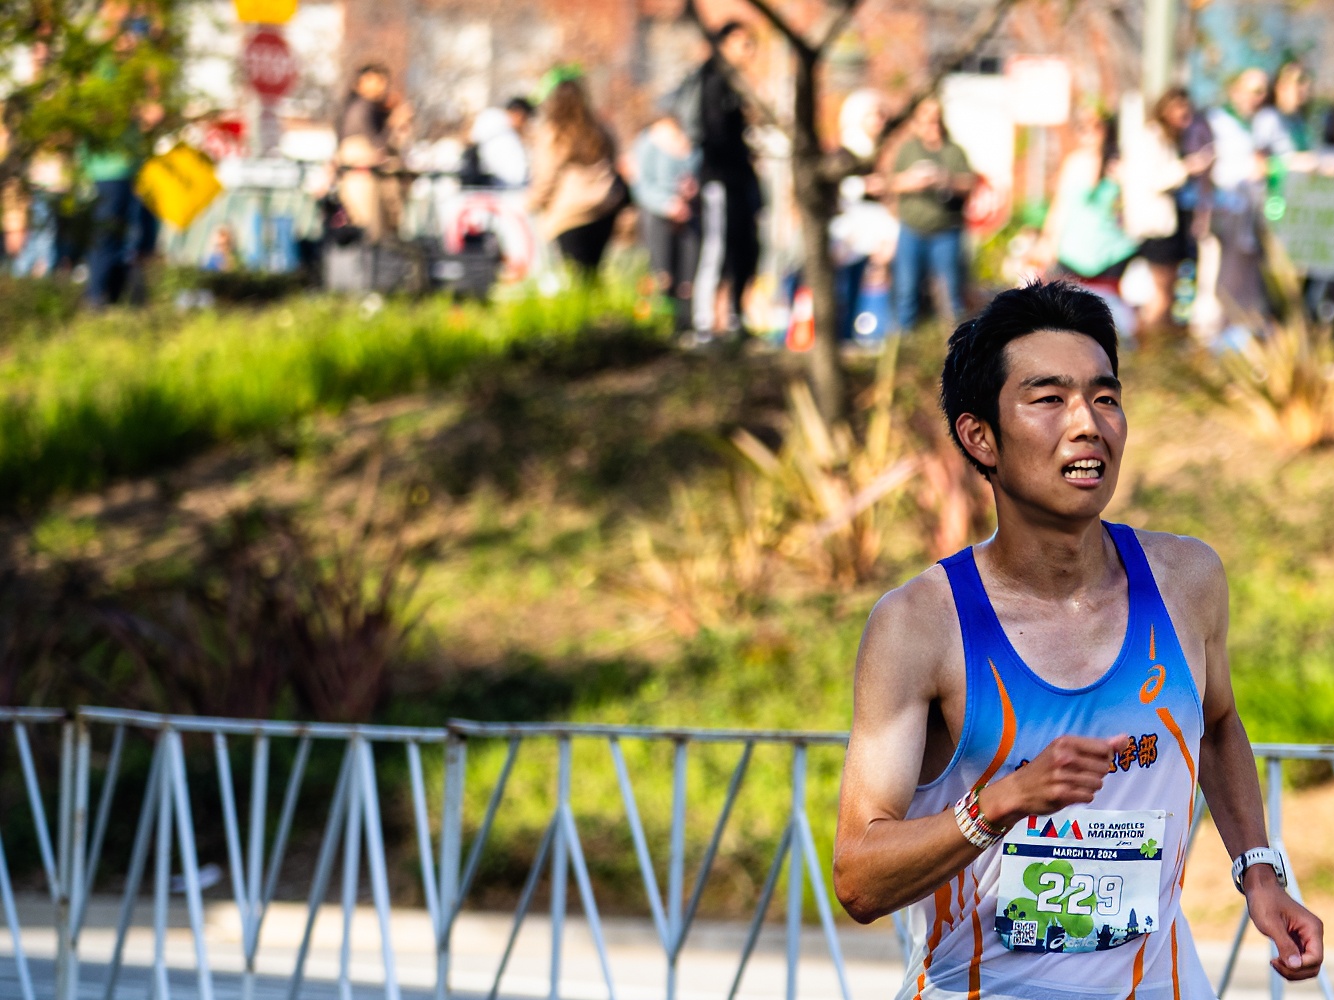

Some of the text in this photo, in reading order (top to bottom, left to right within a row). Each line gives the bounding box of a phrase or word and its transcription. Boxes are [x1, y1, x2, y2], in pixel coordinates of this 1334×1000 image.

[1088, 822, 1145, 830] LOS ANGELES
[1087, 830, 1145, 839] MARATHON
[1052, 848, 1118, 859] MARCH 17, 2024
[1036, 872, 1124, 916] 229
